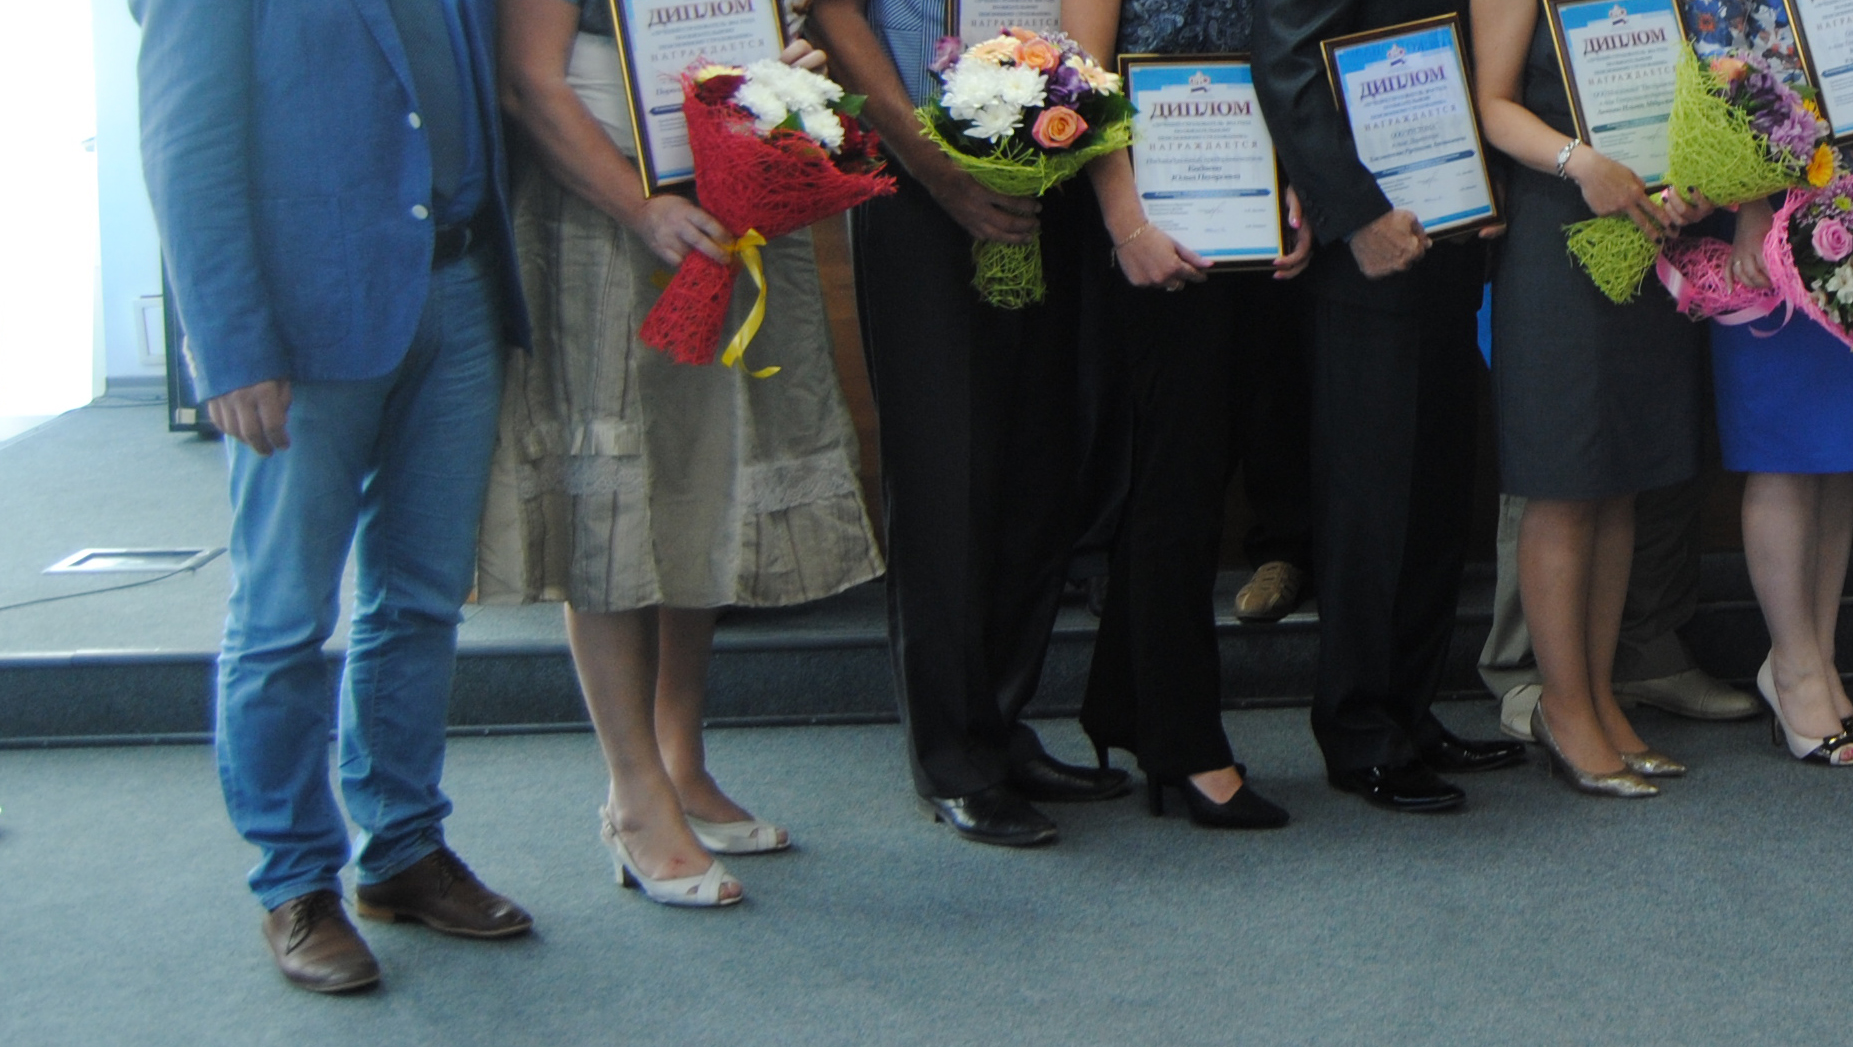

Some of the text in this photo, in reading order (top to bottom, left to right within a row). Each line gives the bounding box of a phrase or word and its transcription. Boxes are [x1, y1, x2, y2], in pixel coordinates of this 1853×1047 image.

[650, 38, 766, 63] НАГРАЖДАЕТСЯ
[1583, 27, 1667, 56] ДИПЛОМ
[1360, 64, 1447, 102] ДИПЛОМ
[1150, 101, 1253, 120] ДИПЛОМ
[1364, 104, 1458, 132] НАГРАЖДАЕТСЯ
[1149, 140, 1259, 151] НАГРАЖДАЕТСЯ
